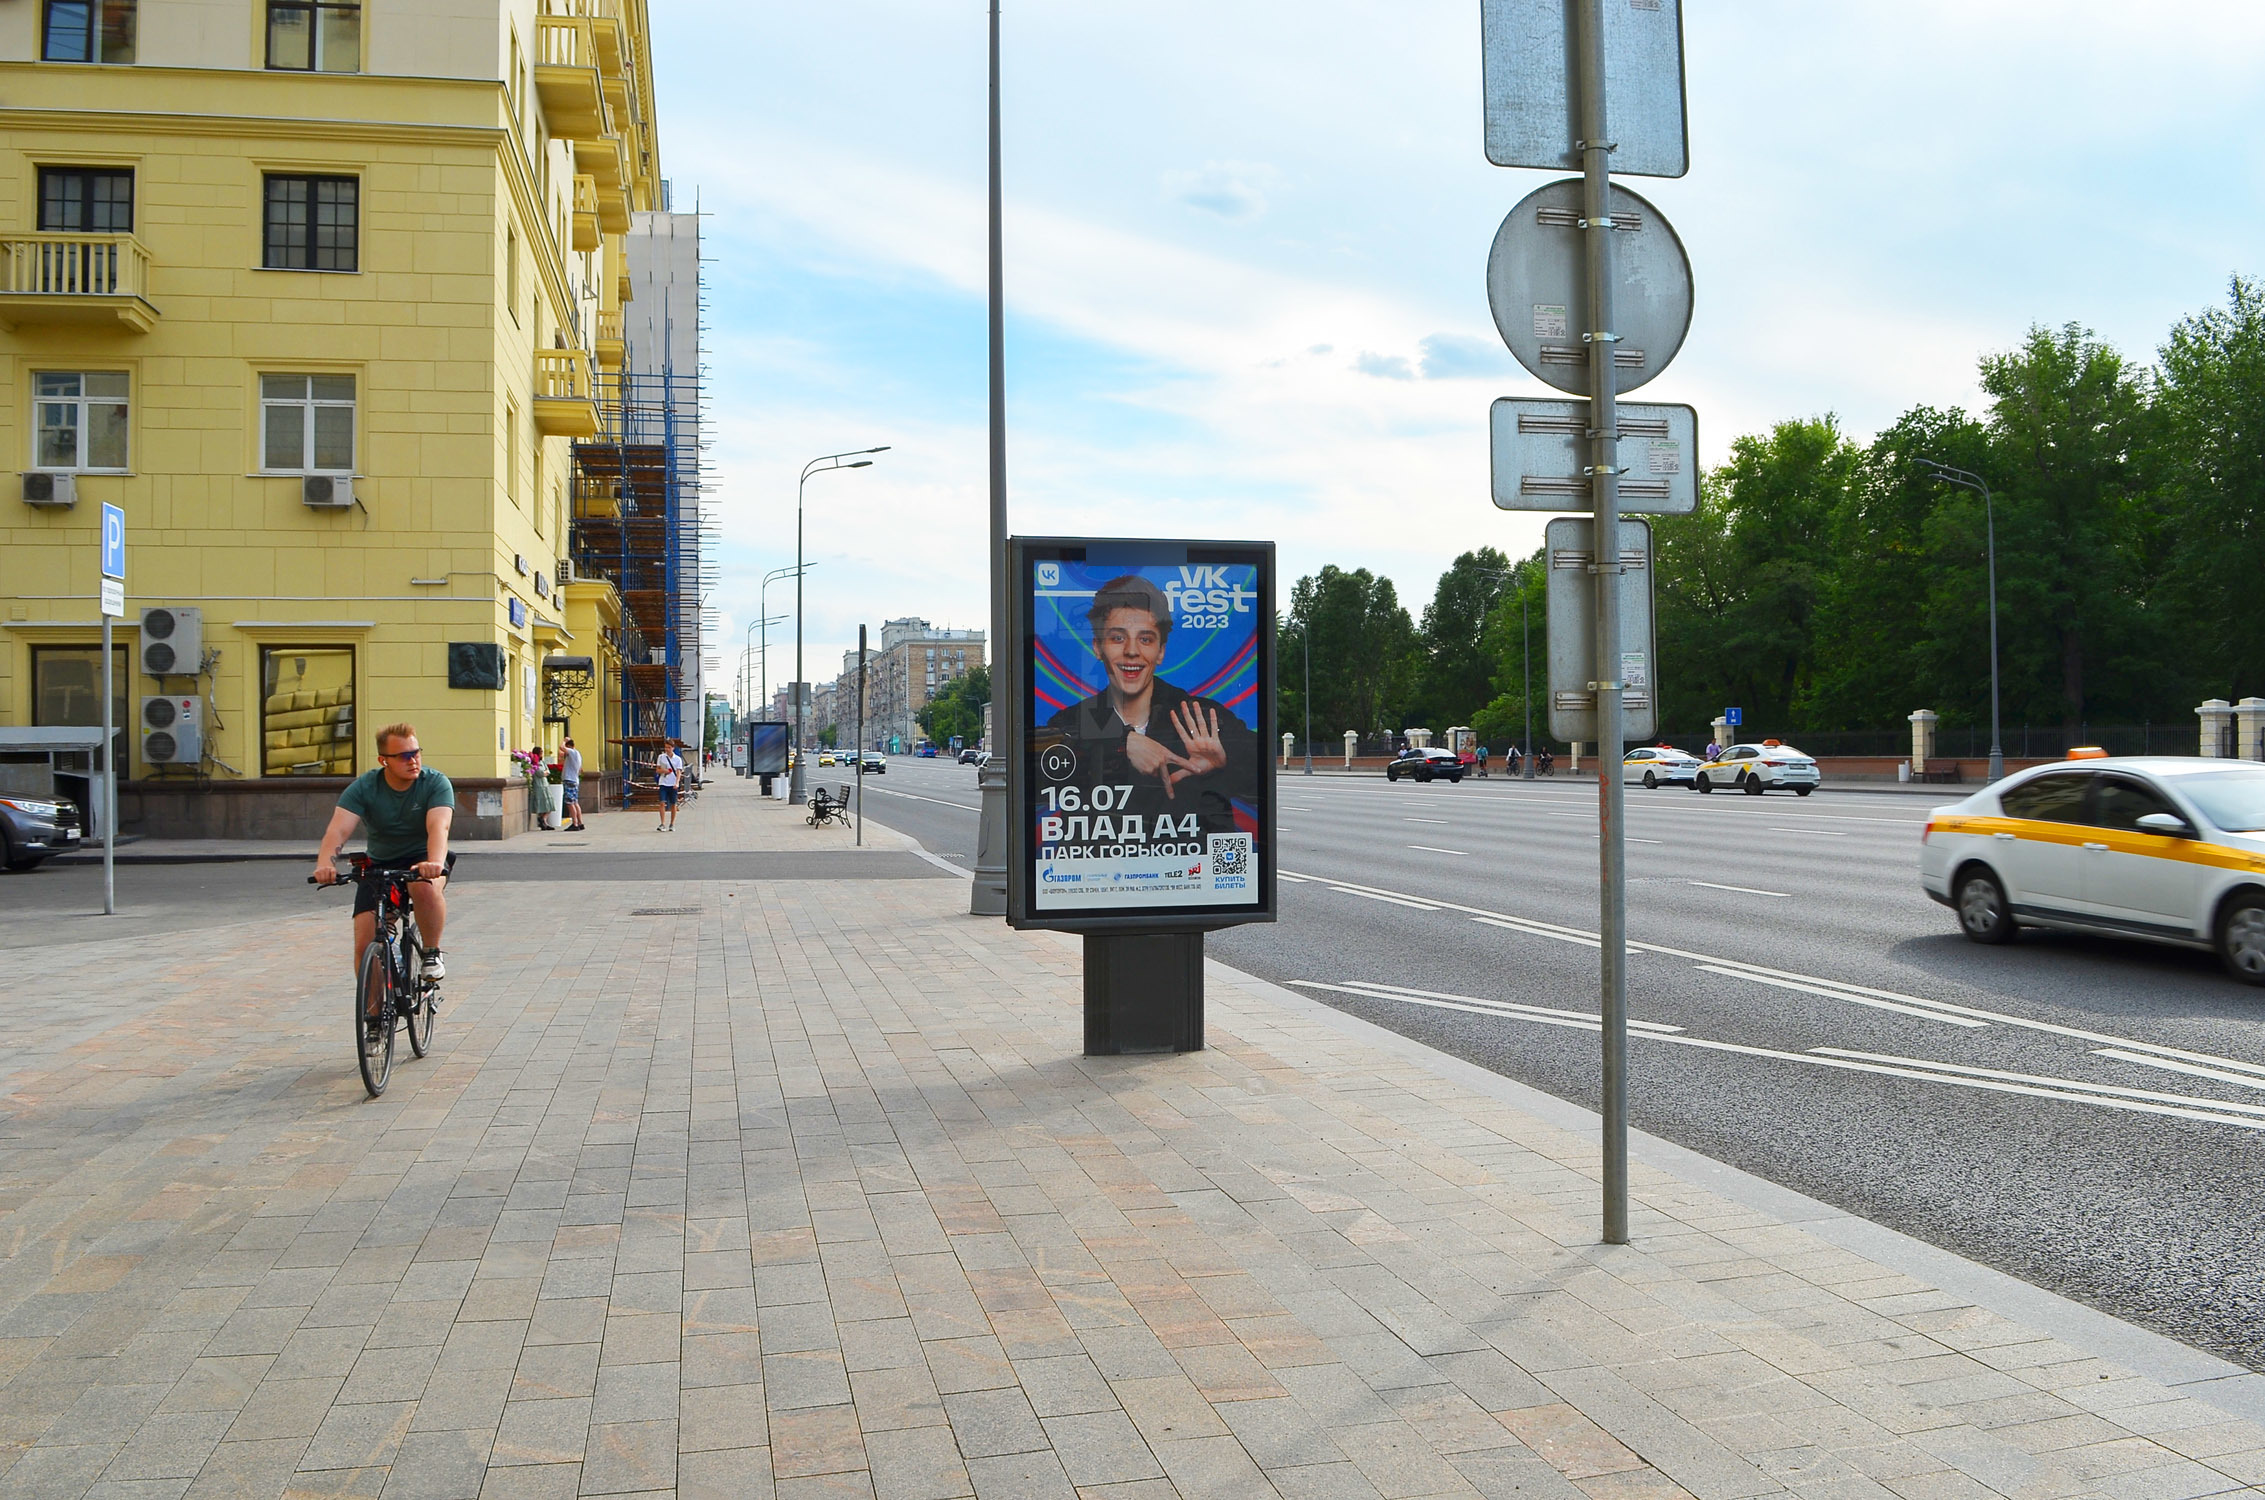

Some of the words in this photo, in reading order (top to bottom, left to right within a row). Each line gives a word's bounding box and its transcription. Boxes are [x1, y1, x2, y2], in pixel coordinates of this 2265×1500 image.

[1041, 569, 1056, 580] VK
[1178, 565, 1230, 589] VK
[1163, 580, 1250, 613] fest
[1181, 614, 1229, 629] 2023
[1048, 755, 1071, 771] 0+
[1040, 784, 1134, 812] 16.07
[1041, 815, 1147, 844] ВЛАД
[1152, 813, 1201, 839] А4
[1041, 845, 1095, 860] ПАРК
[1100, 842, 1202, 859] ГОРЬКОГО
[1164, 870, 1183, 879] TELE2
[1215, 875, 1246, 883] КУПИТЬ
[1214, 882, 1246, 890] БИЛЕТЫ
